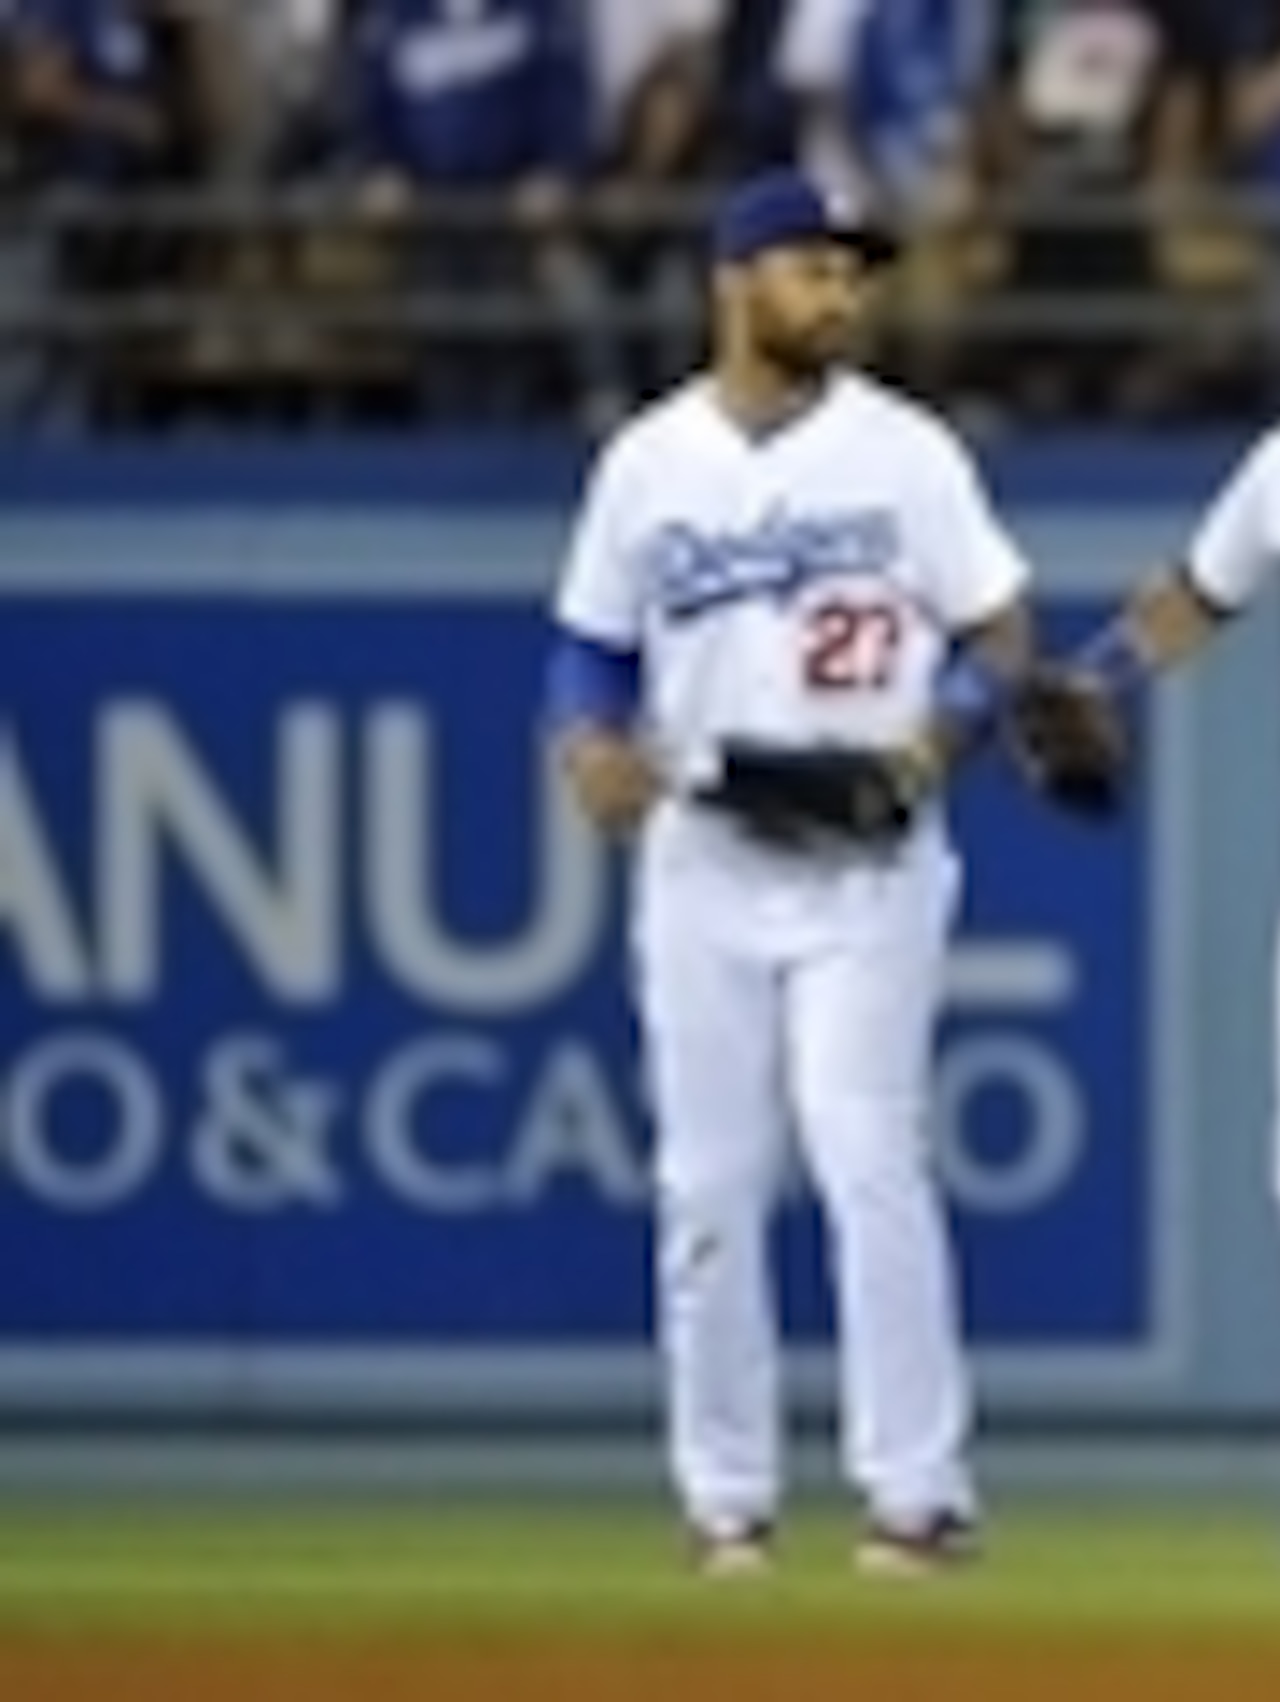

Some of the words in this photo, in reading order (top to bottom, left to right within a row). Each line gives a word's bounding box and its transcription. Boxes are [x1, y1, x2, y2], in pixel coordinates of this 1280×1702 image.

[645, 503, 903, 618] Dodgers
[803, 602, 898, 692] 27
[193, 1033, 342, 1212] &
